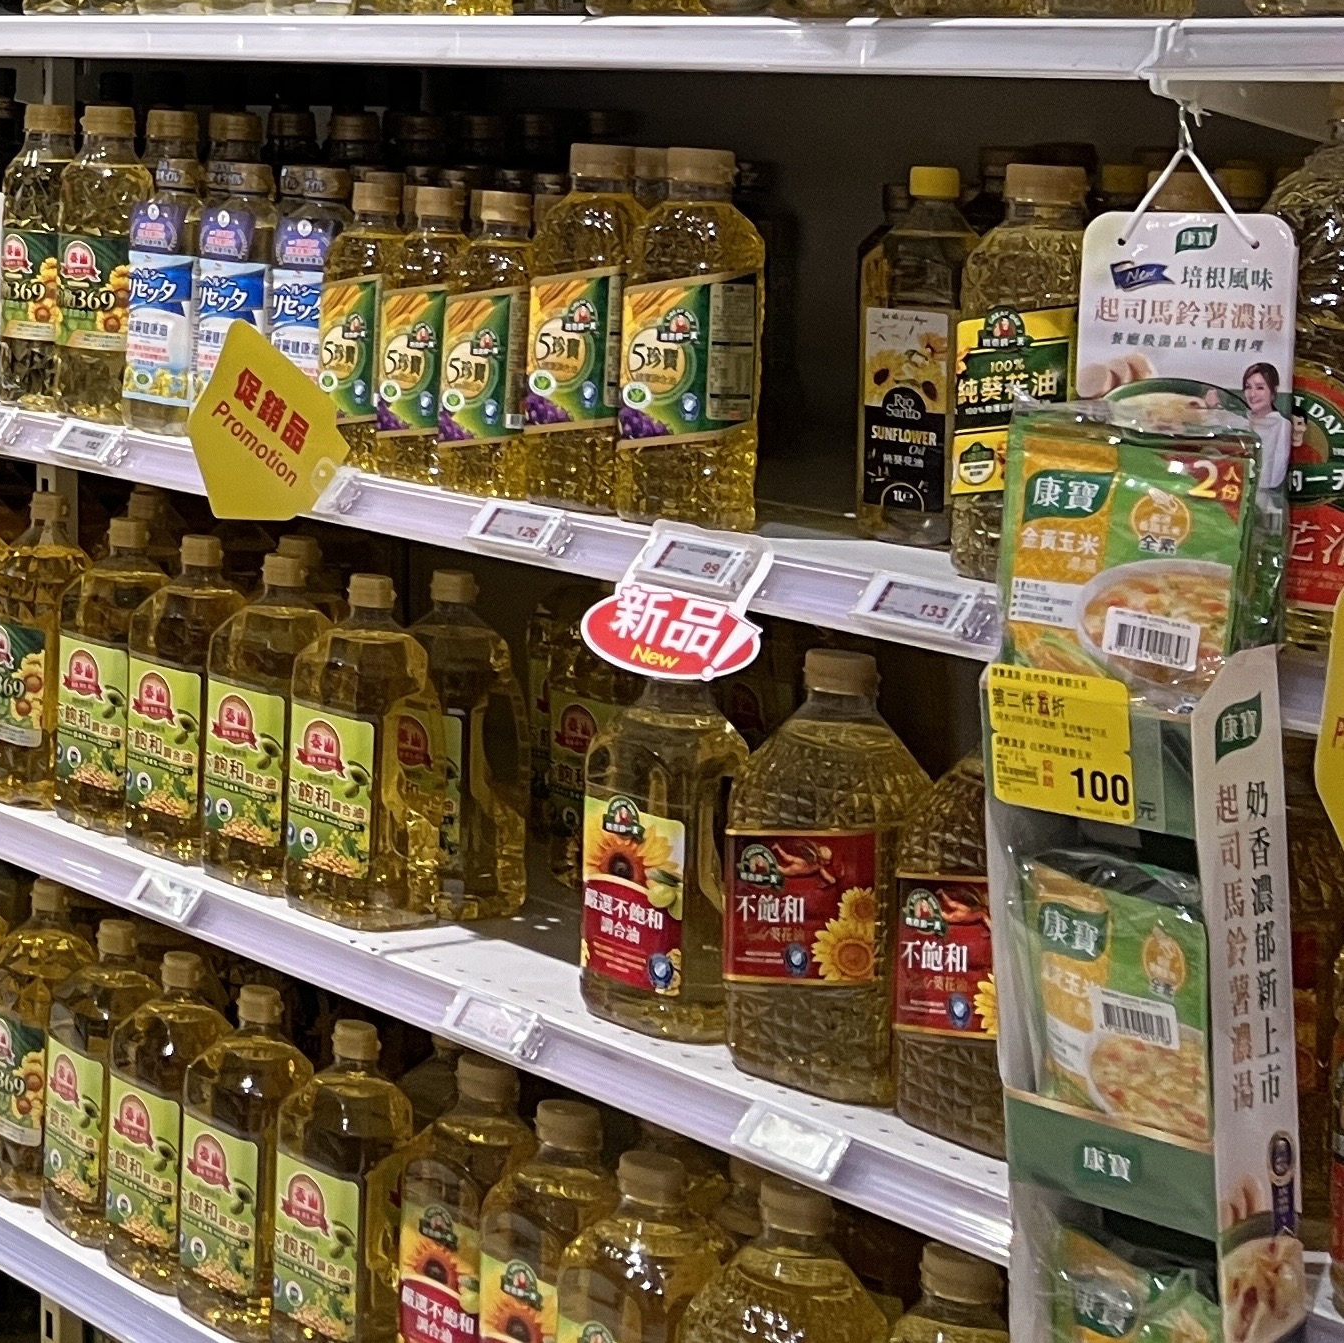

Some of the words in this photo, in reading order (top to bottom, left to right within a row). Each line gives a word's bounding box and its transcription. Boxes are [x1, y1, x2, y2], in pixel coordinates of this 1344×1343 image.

[1125, 267, 1157, 283] New
[1180, 265, 1274, 292] 培根風味
[1094, 295, 1285, 332] 起司馬鈴薯濃湯
[536, 332, 581, 361] 5珍寶
[630, 343, 679, 372] 5珍寶
[989, 358, 1026, 374] 100%
[893, 393, 916, 410] Rio
[957, 369, 1059, 406] 純葵花油
[233, 365, 311, 456] 促銷品
[885, 403, 922, 421] Santo
[211, 402, 299, 489] Promotion
[871, 424, 938, 447] SUNFLOWER
[908, 444, 926, 457] Oil
[1031, 475, 1101, 514] 康寶
[1187, 459, 1219, 498] 2
[516, 524, 540, 539] 126
[701, 560, 721, 575] 99
[918, 602, 950, 620] 133
[630, 644, 680, 671] New
[1220, 708, 1258, 744] 康寶
[1069, 766, 1131, 807] 100
[735, 892, 806, 925] 不飽和
[1042, 905, 1100, 958] 康寶
[1214, 783, 1255, 1113] 起司馬鈴薯濃湯
[1244, 779, 1282, 1105] 奶香濃郁新上市
[900, 940, 970, 974] 不飽和
[1082, 1144, 1133, 1184] 康寶
